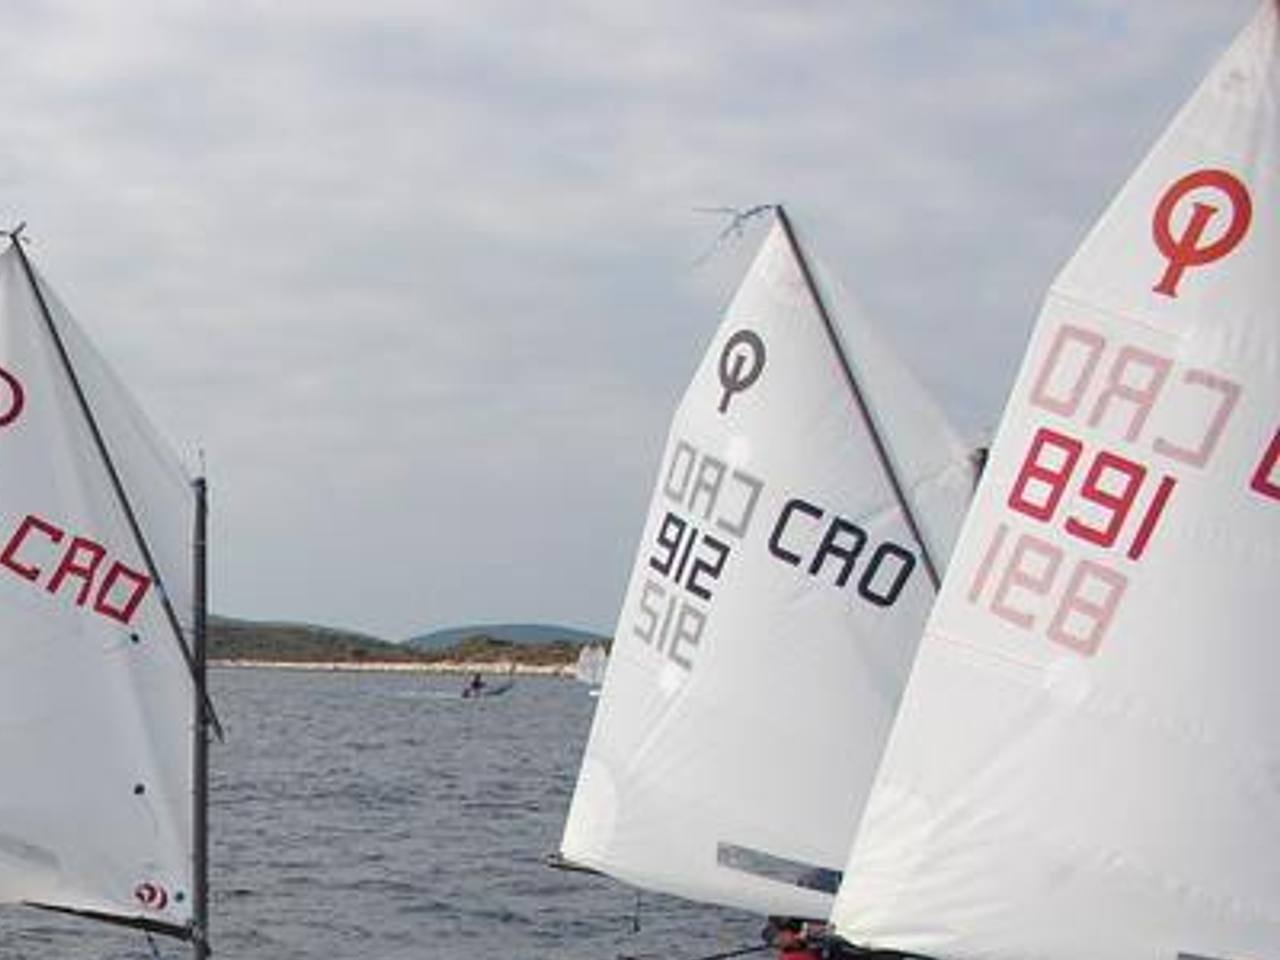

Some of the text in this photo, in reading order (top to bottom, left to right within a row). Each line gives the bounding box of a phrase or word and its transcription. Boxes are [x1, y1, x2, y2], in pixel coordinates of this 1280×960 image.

[1008, 426, 1177, 562] 891
[649, 511, 731, 601] 912
[768, 498, 917, 608] CRO
